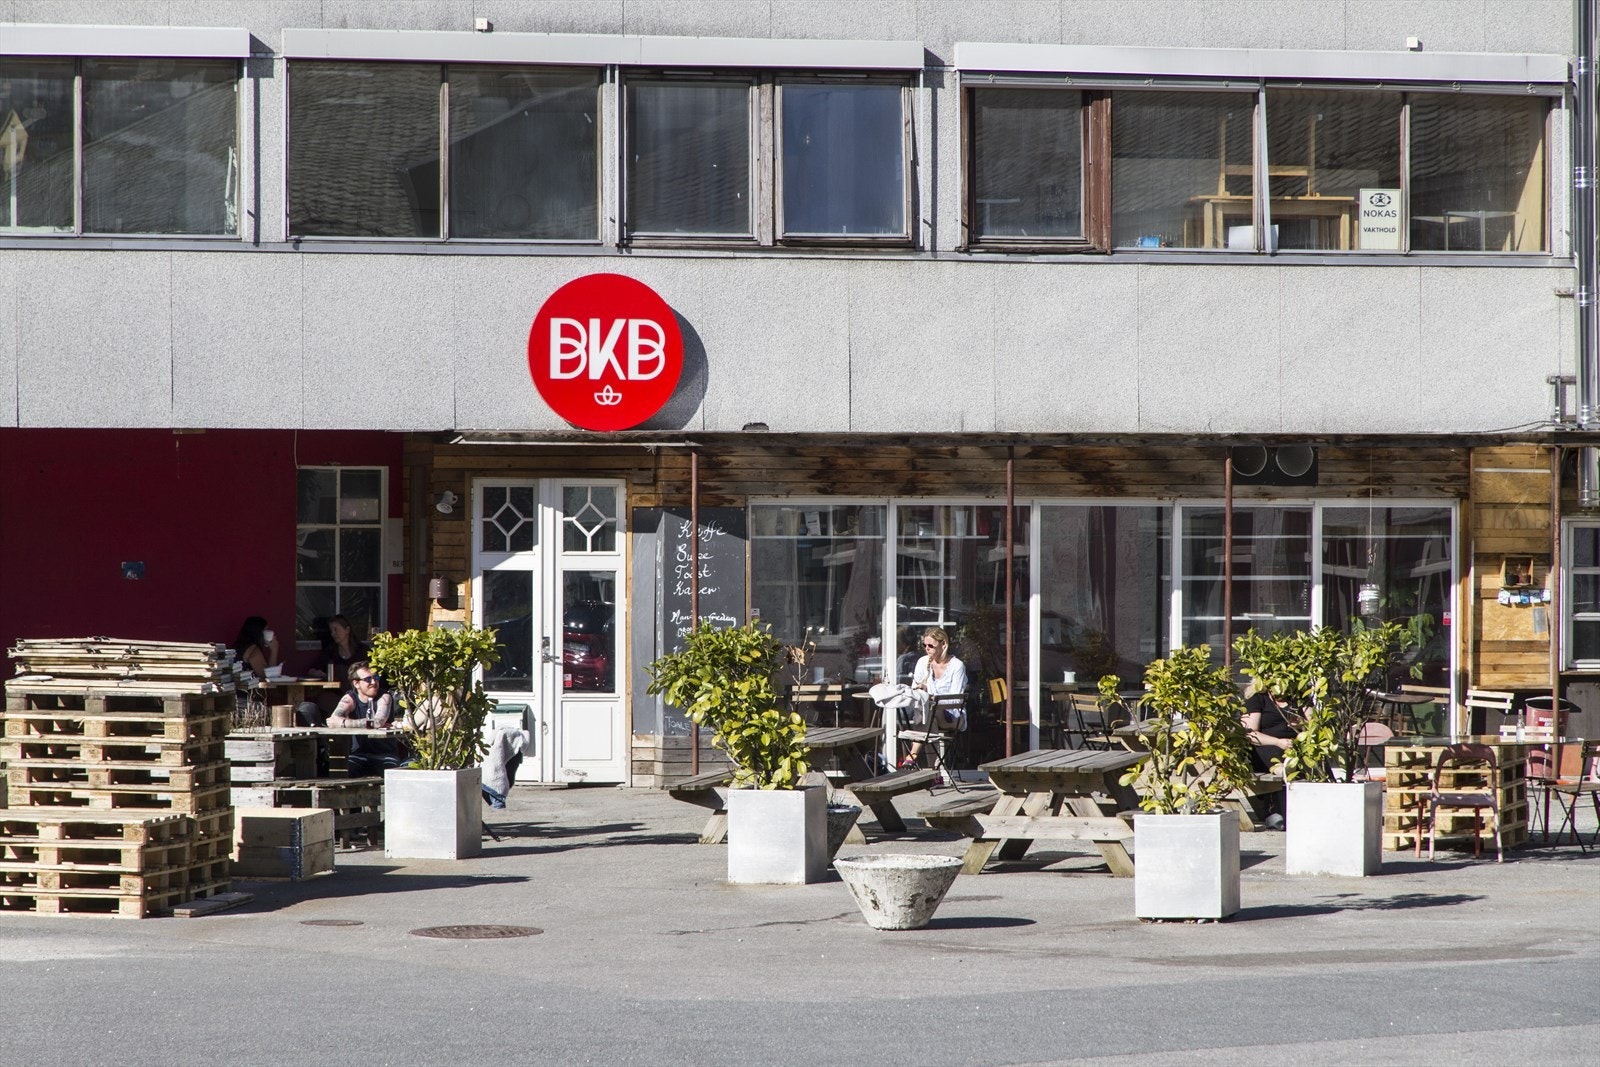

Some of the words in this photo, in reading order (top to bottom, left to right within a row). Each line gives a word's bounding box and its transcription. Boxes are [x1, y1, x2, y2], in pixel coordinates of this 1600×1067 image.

[1363, 209, 1397, 218] NOKAS
[549, 317, 666, 381] BKB
[675, 563, 712, 579] Tost
[673, 580, 718, 596] Kaer
